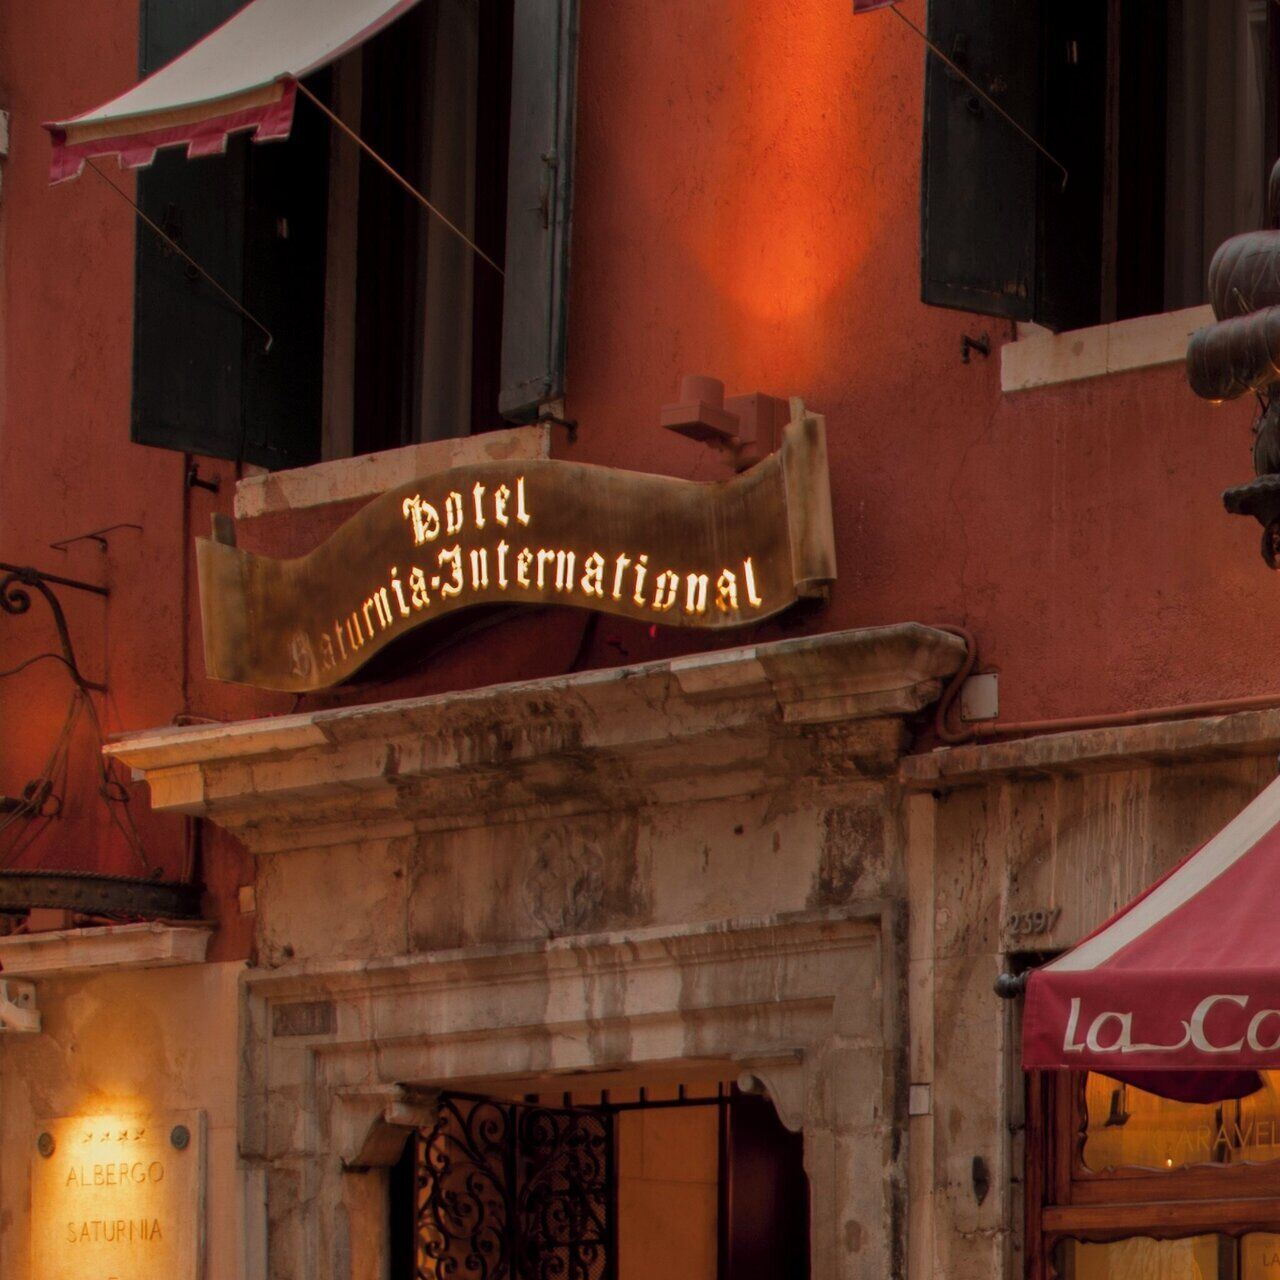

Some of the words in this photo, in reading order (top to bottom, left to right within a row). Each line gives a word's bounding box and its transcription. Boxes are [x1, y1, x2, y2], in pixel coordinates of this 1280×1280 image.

[402, 476, 531, 545] Hotel
[66, 1160, 165, 1188] ALBERGO
[66, 1218, 163, 1244] SATURNIA
